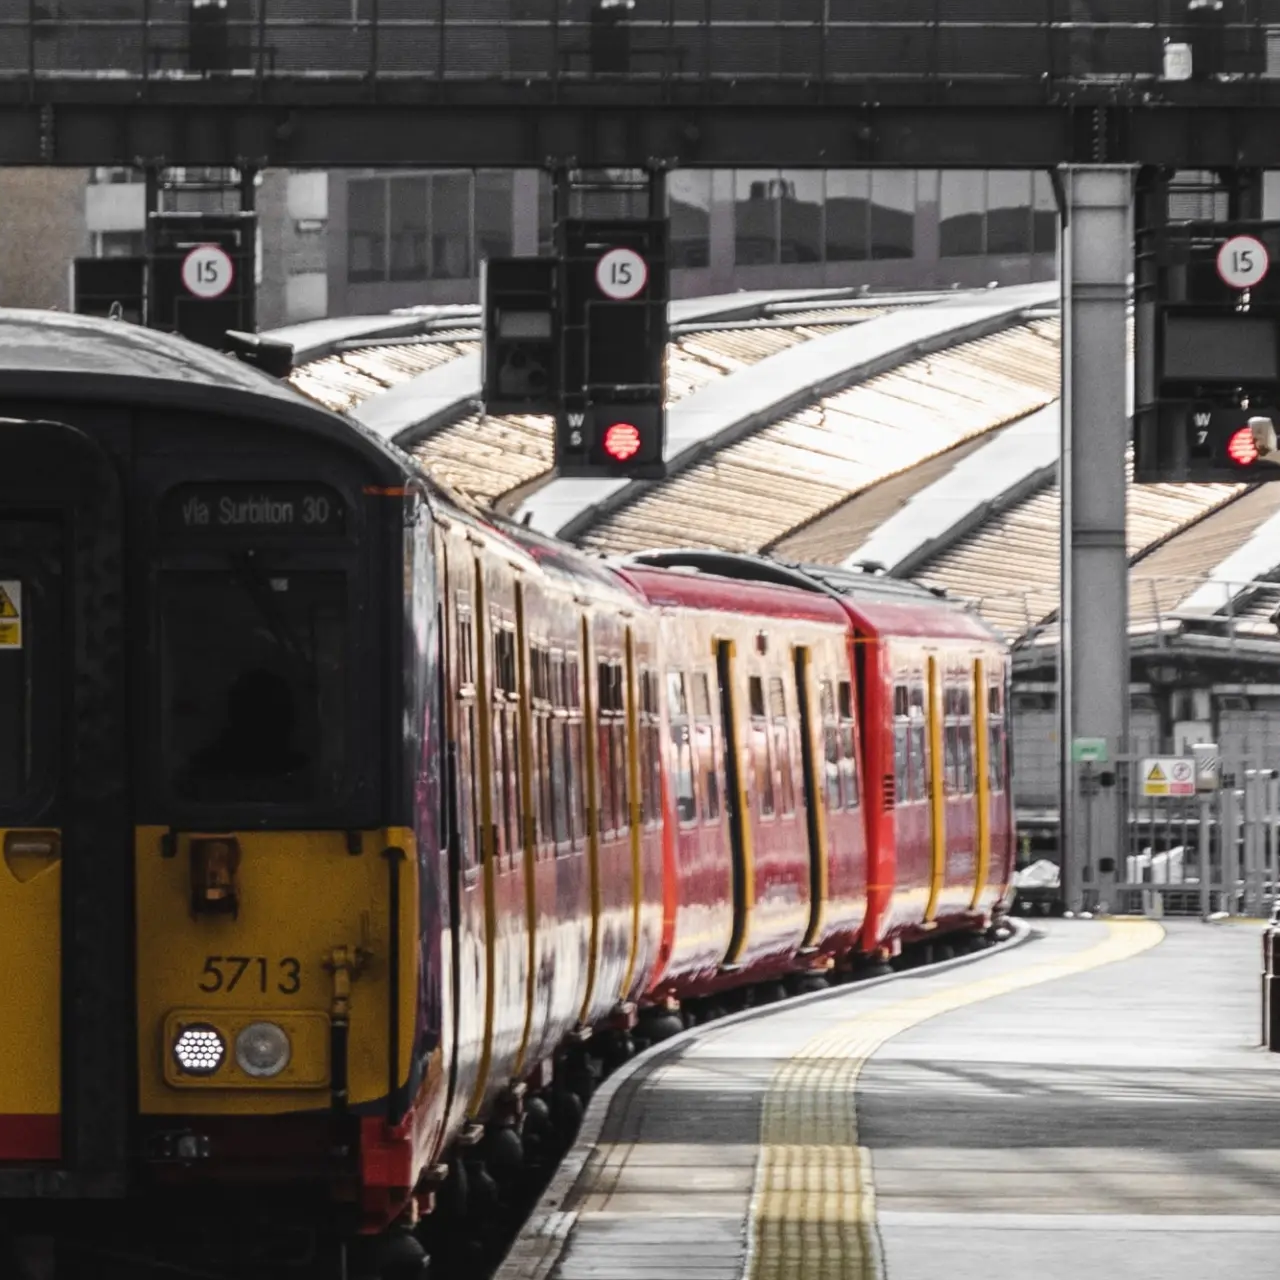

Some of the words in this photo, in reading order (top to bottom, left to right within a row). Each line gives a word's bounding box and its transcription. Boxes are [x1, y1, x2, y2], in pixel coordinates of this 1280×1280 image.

[197, 260, 218, 284] 15
[1232, 250, 1254, 273] 15
[610, 262, 632, 285] 15
[568, 413, 585, 428] W
[1193, 412, 1211, 427] W
[1197, 431, 1208, 444] 7
[219, 494, 294, 524] Surbiton
[302, 494, 330, 524] 30
[198, 955, 301, 994] 5713
